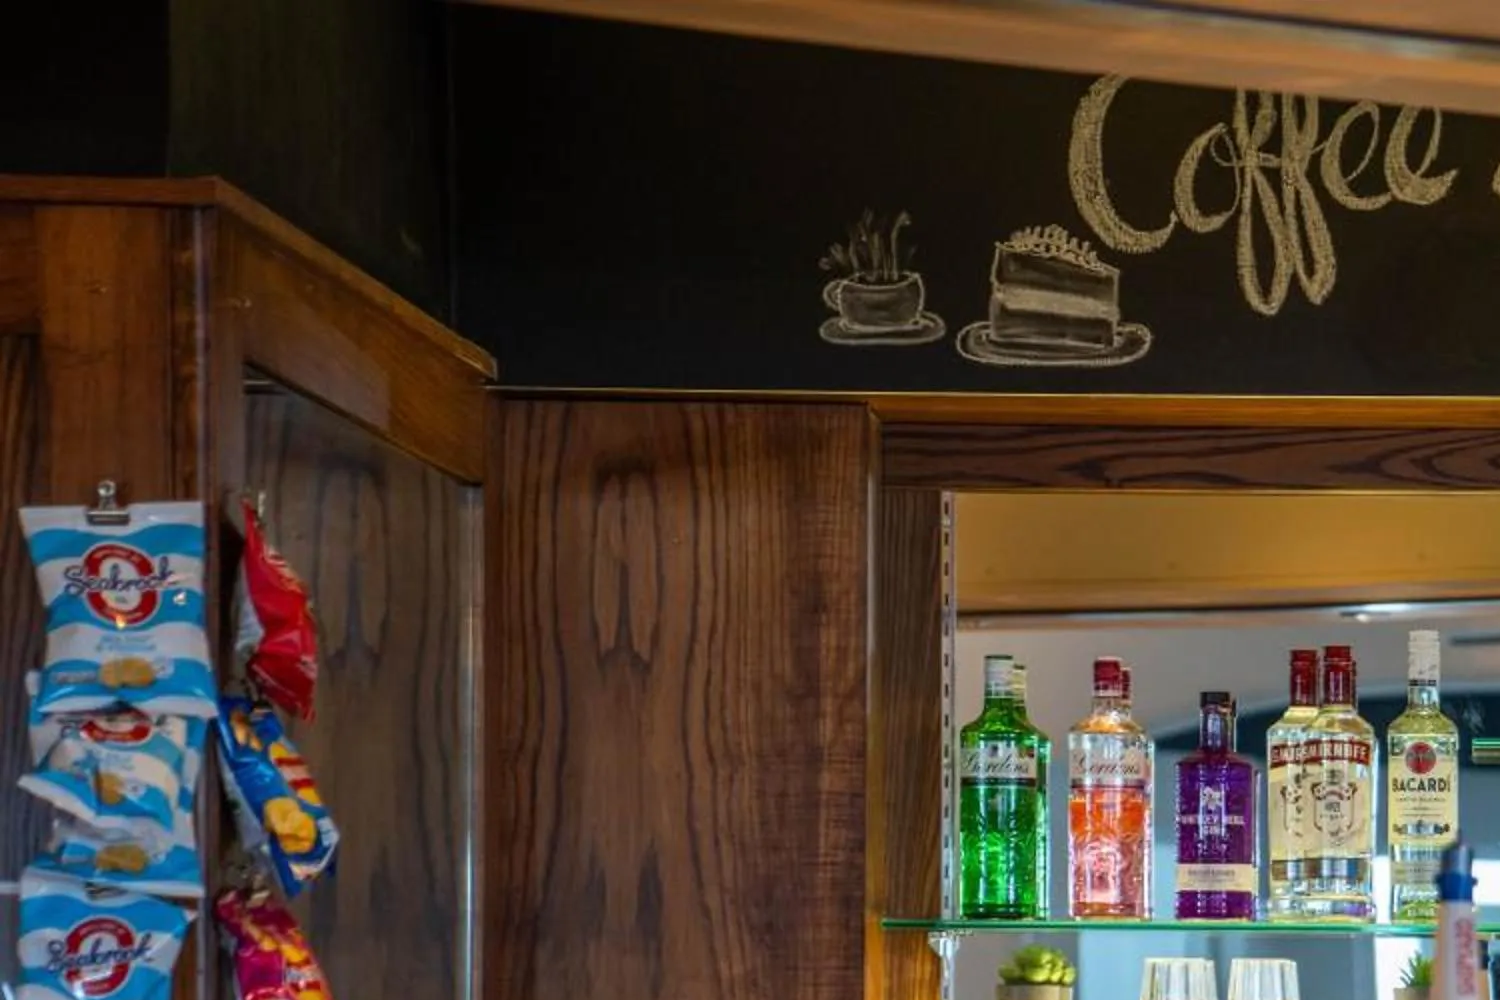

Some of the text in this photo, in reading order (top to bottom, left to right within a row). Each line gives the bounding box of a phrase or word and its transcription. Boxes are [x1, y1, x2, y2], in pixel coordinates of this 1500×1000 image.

[1067, 72, 1458, 317] Coffee
[63, 556, 175, 597] Seabrook
[1303, 740, 1370, 764] SMIRNOFF
[46, 932, 152, 974] Seabrook
